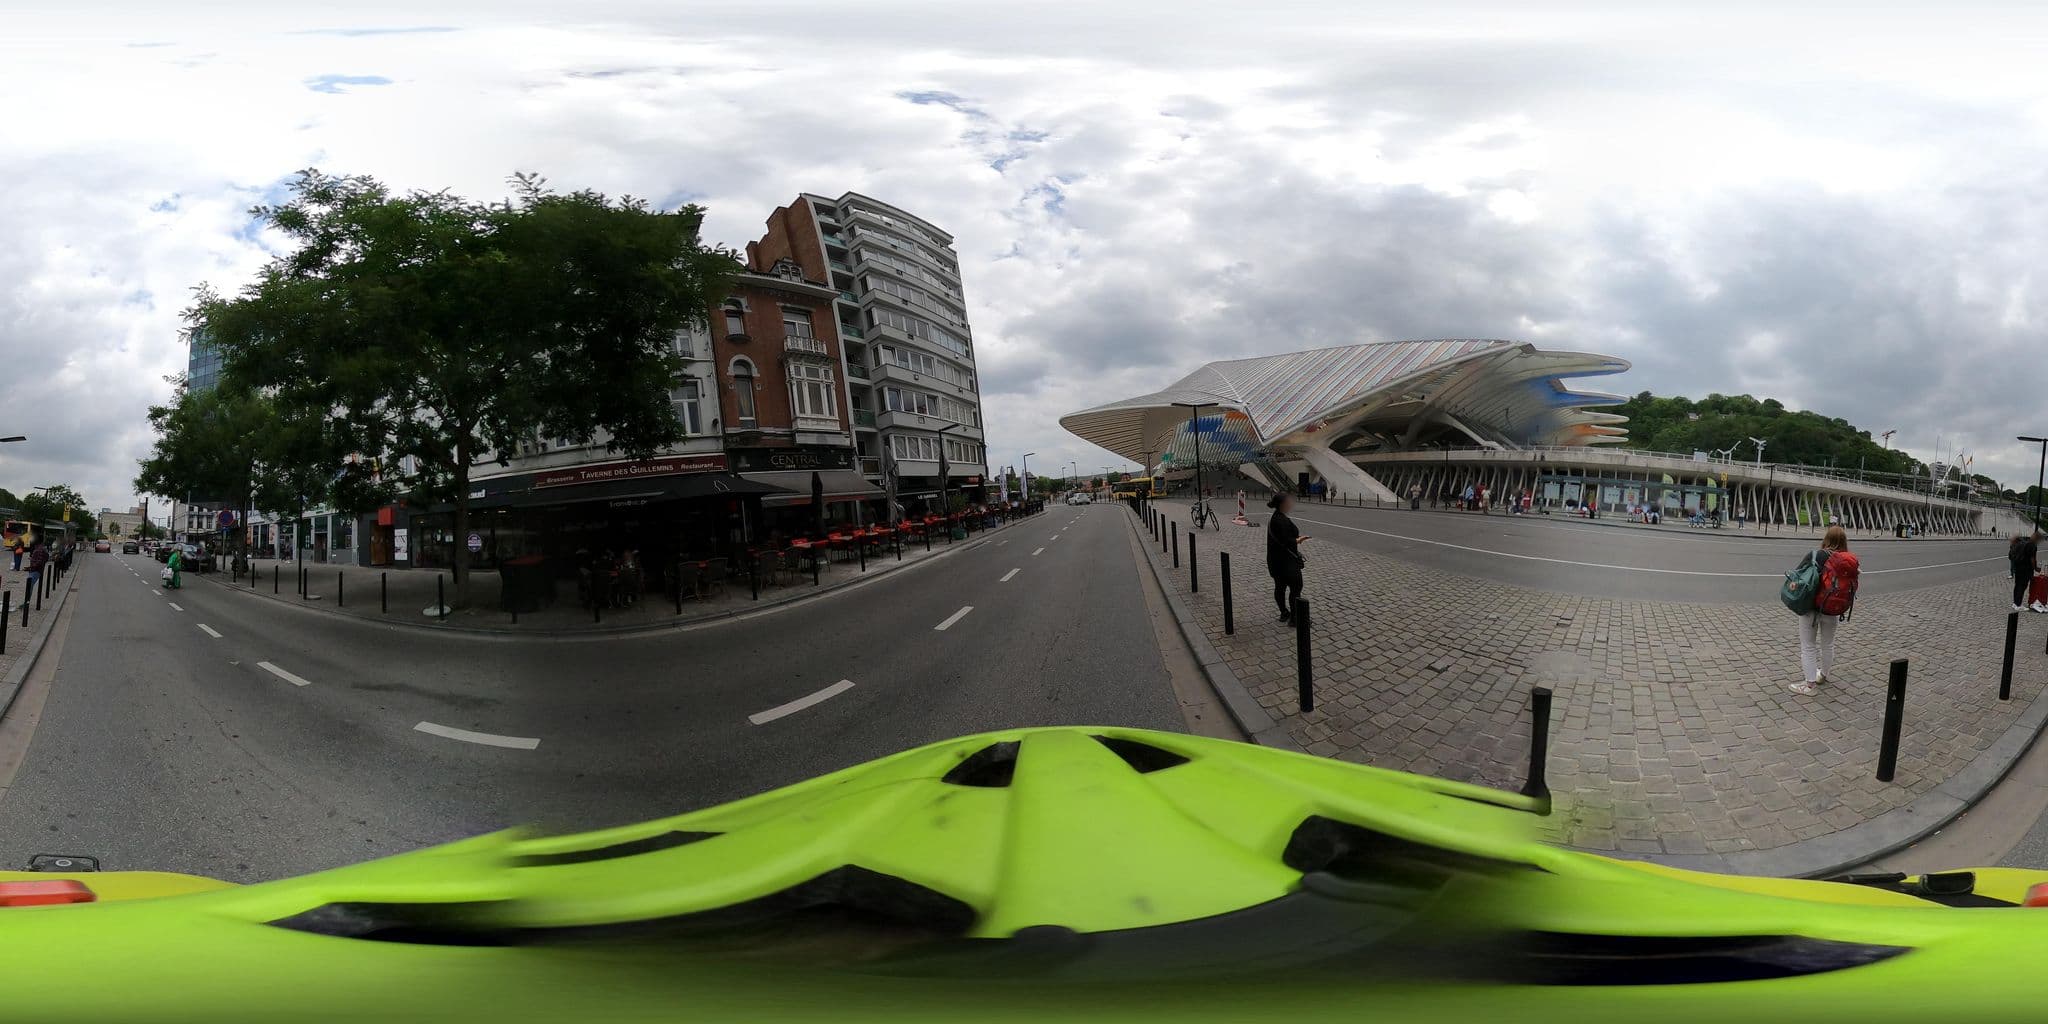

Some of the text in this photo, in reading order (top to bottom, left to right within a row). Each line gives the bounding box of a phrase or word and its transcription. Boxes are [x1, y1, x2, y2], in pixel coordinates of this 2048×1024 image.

[770, 454, 822, 465] CENTRAL
[580, 471, 613, 480] TAVERNE
[614, 468, 628, 476] DES
[629, 464, 674, 475] GUILLEMINS
[680, 462, 714, 470] Restaurant
